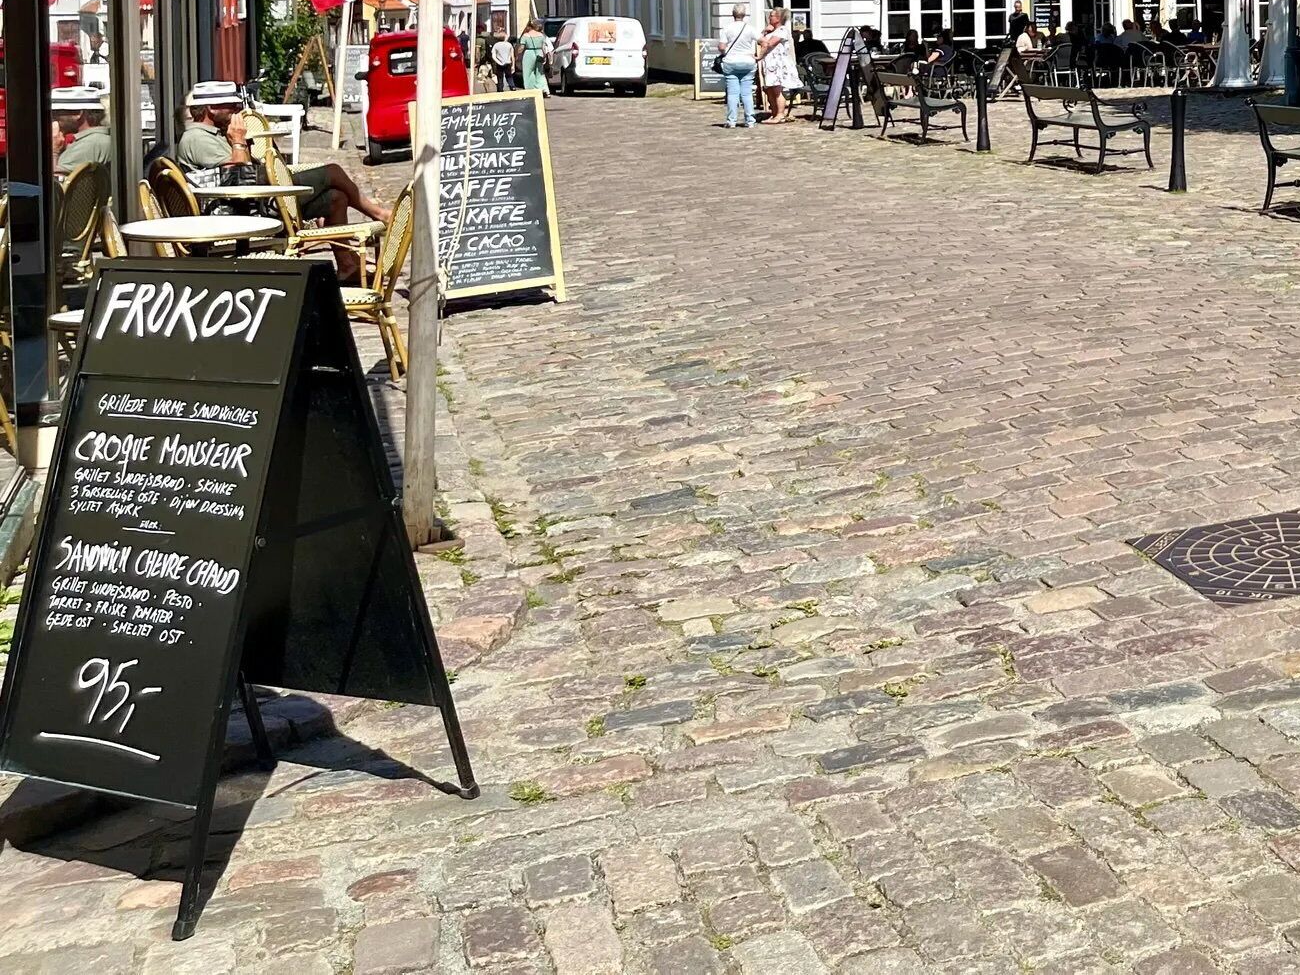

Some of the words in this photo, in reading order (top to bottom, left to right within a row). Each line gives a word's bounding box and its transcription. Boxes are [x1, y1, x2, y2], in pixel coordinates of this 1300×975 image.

[453, 130, 485, 149] IS
[440, 177, 512, 199] KAFFE
[439, 211, 458, 228] IS
[466, 204, 527, 225] KAFFE
[467, 233, 525, 251] CACAO
[95, 281, 286, 342] FROKOST
[152, 399, 187, 417] VARME
[75, 431, 155, 475] CROQUE
[70, 485, 79, 499] 3
[137, 491, 160, 506] OSTE
[69, 499, 103, 514] SYLTET
[186, 559, 240, 595] CHAUD
[162, 588, 193, 609] PESTO
[132, 605, 174, 624] TOMATER
[111, 620, 154, 637] SMELTET
[159, 628, 185, 645] OST
